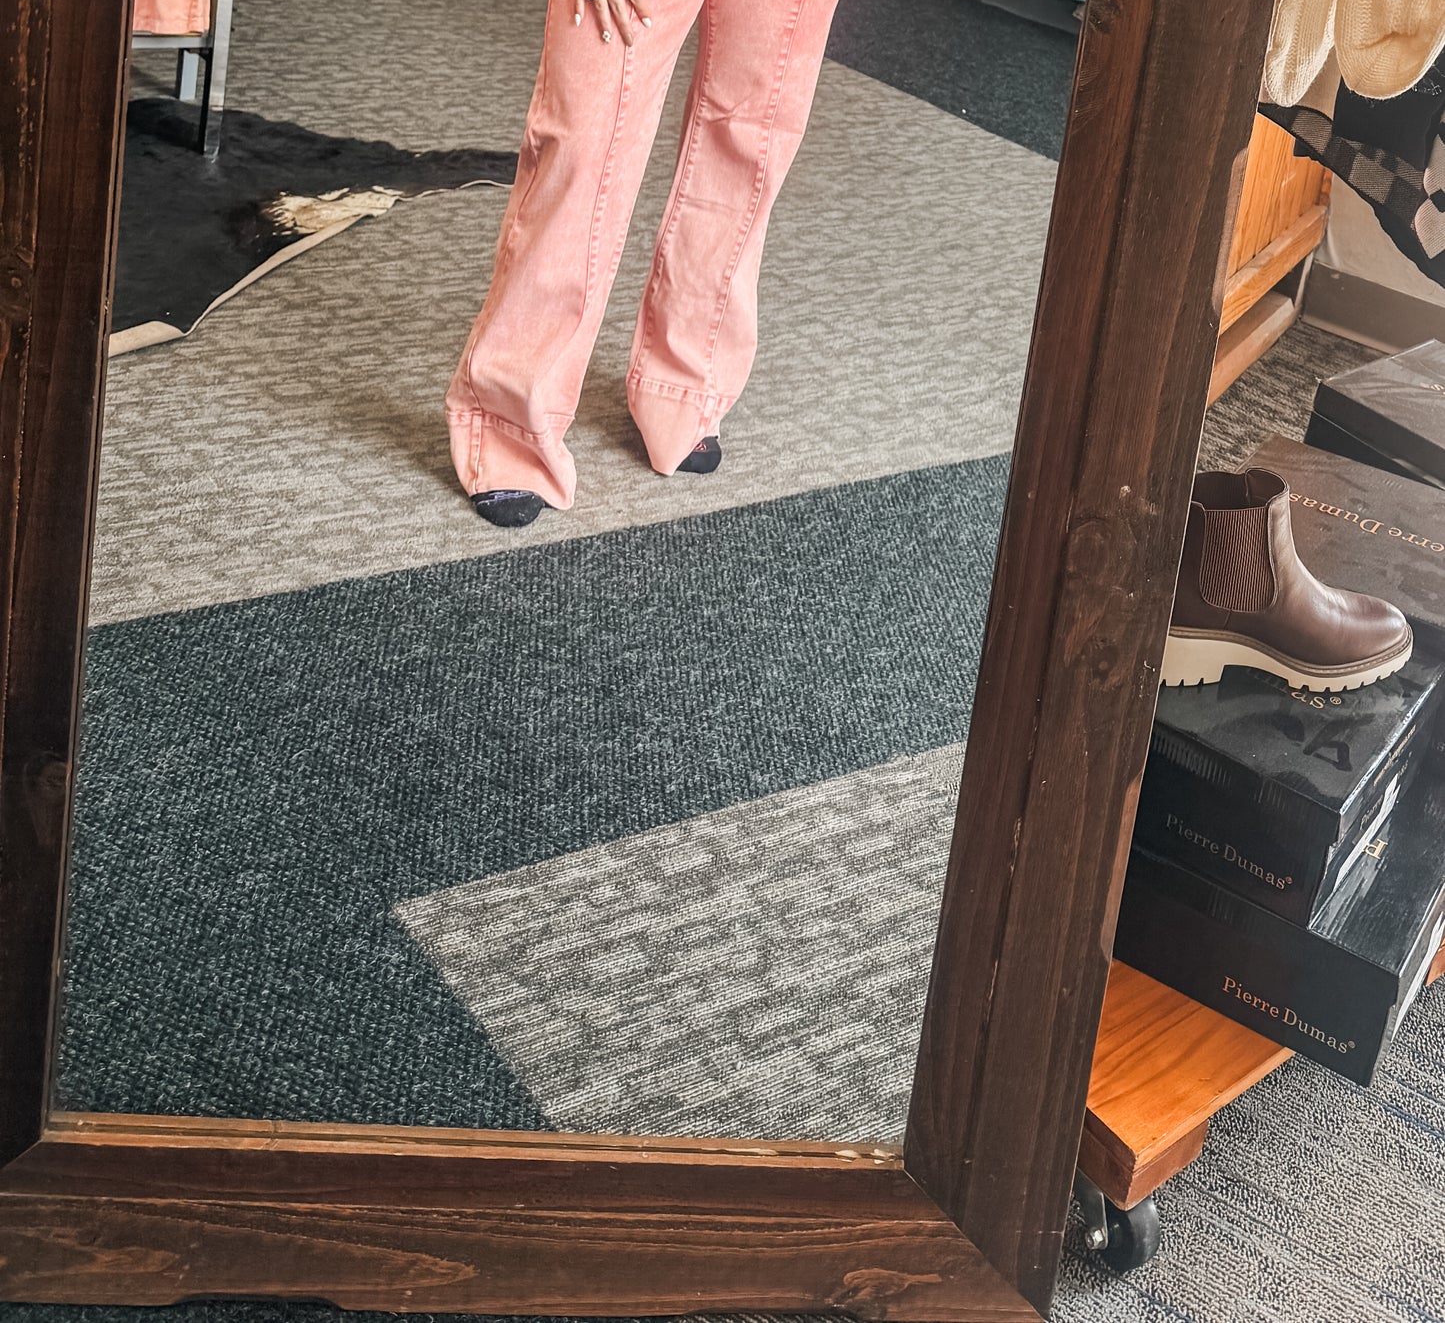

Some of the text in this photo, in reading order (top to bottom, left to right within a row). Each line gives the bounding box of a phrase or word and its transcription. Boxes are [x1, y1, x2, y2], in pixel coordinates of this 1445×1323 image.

[1388, 526, 1445, 552] erre
[1166, 813, 1219, 854] Pierre
[1222, 976, 1279, 1018] Pierre
